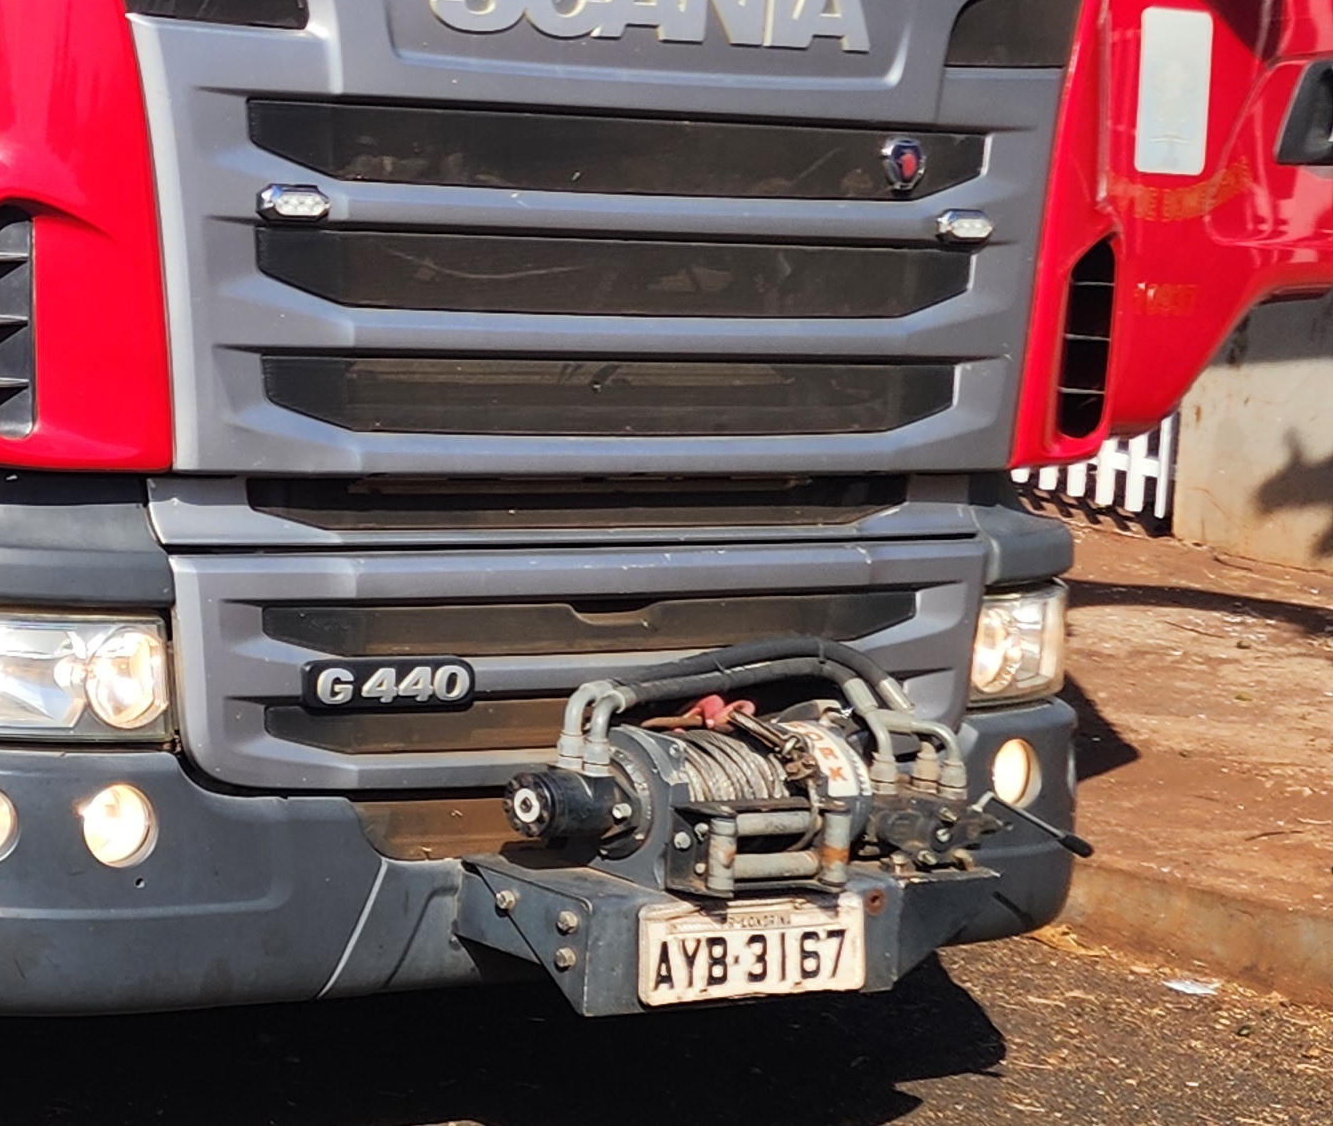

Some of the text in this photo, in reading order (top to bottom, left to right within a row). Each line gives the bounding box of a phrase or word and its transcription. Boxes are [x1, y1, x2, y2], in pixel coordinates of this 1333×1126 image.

[317, 665, 471, 705] G 440
[654, 929, 847, 991] AYB-3167
